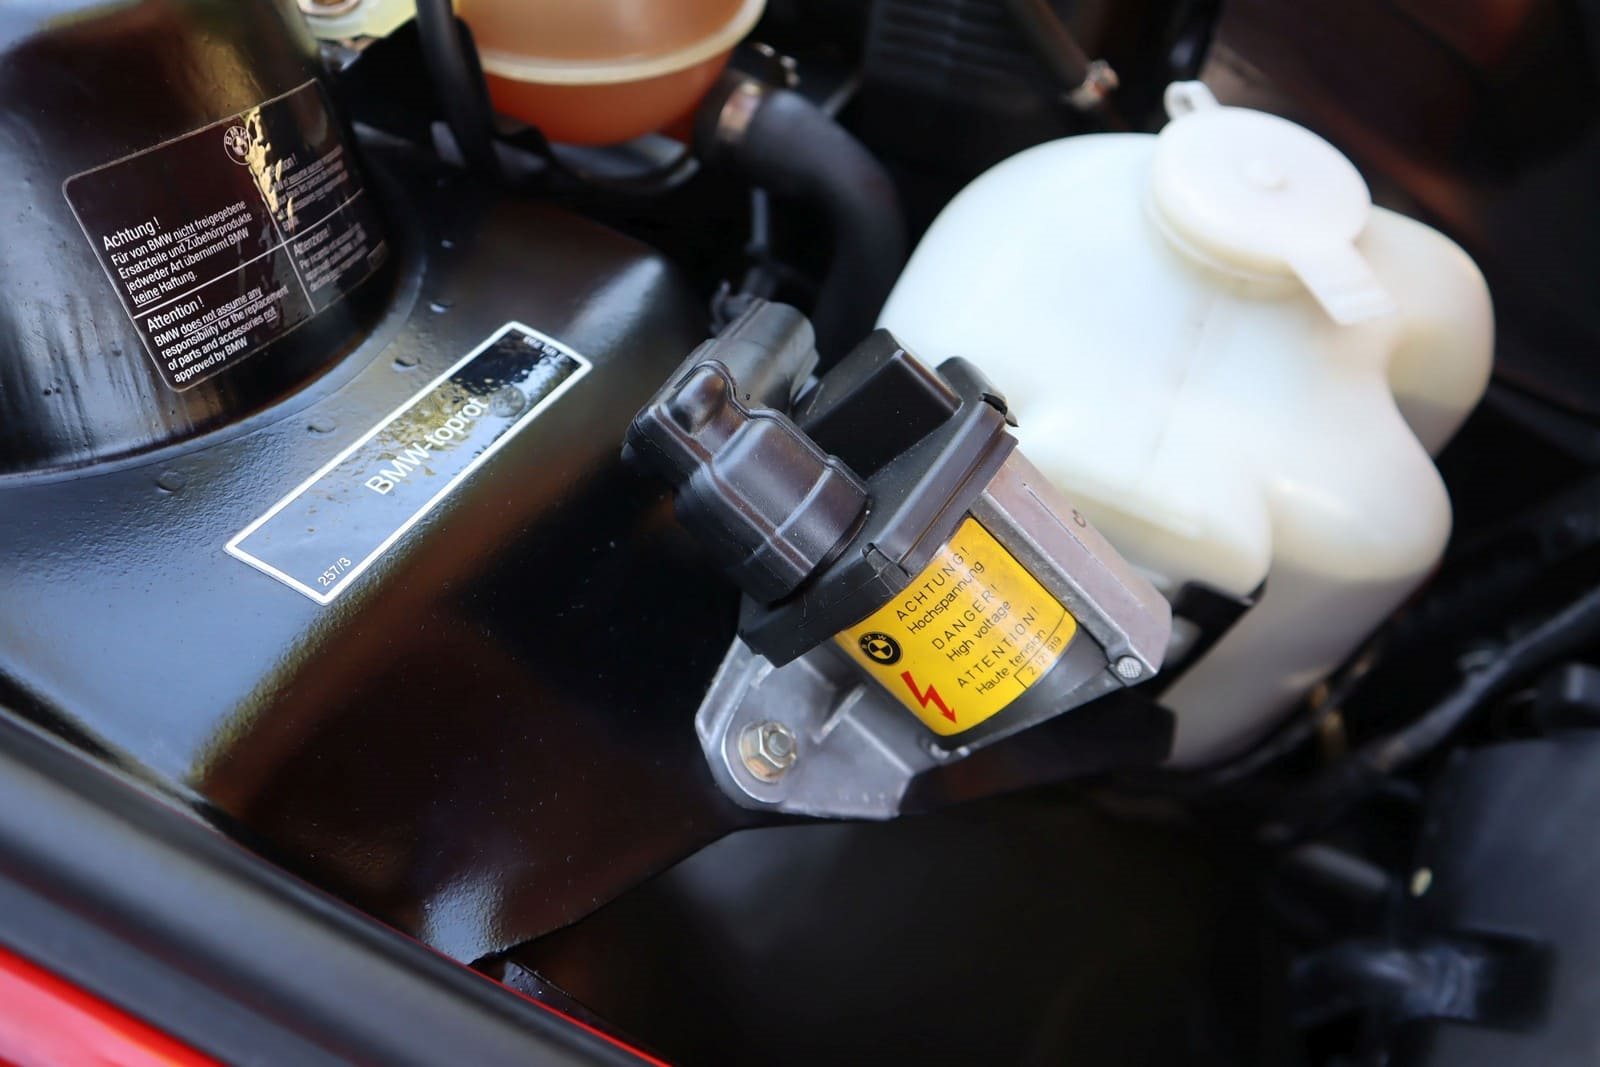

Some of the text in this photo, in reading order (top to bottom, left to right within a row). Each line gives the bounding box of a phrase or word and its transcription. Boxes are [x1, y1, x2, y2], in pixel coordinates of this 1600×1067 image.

[103, 221, 156, 251] Achtung
[111, 201, 247, 266] Für von BMW nicht freigegebene
[118, 252, 168, 279] Ersatzteile
[168, 243, 186, 258] und
[185, 212, 253, 250] Zubehörprodukte
[125, 227, 249, 295] jedweder Art übernimmt BMW
[131, 271, 198, 305] keine Haftung.
[147, 300, 199, 333] Attention
[154, 286, 262, 347] BMW does not assume any
[161, 284, 289, 359] responsibility for the replacement
[168, 305, 277, 371] of parts and accessories not
[174, 336, 248, 383] approved by BMW
[364, 397, 488, 495] BMW-toprot
[317, 557, 352, 586] 257/3
[906, 561, 985, 634] Hochspannung
[946, 601, 1012, 661] High voltage
[975, 667, 1010, 695] Haute
